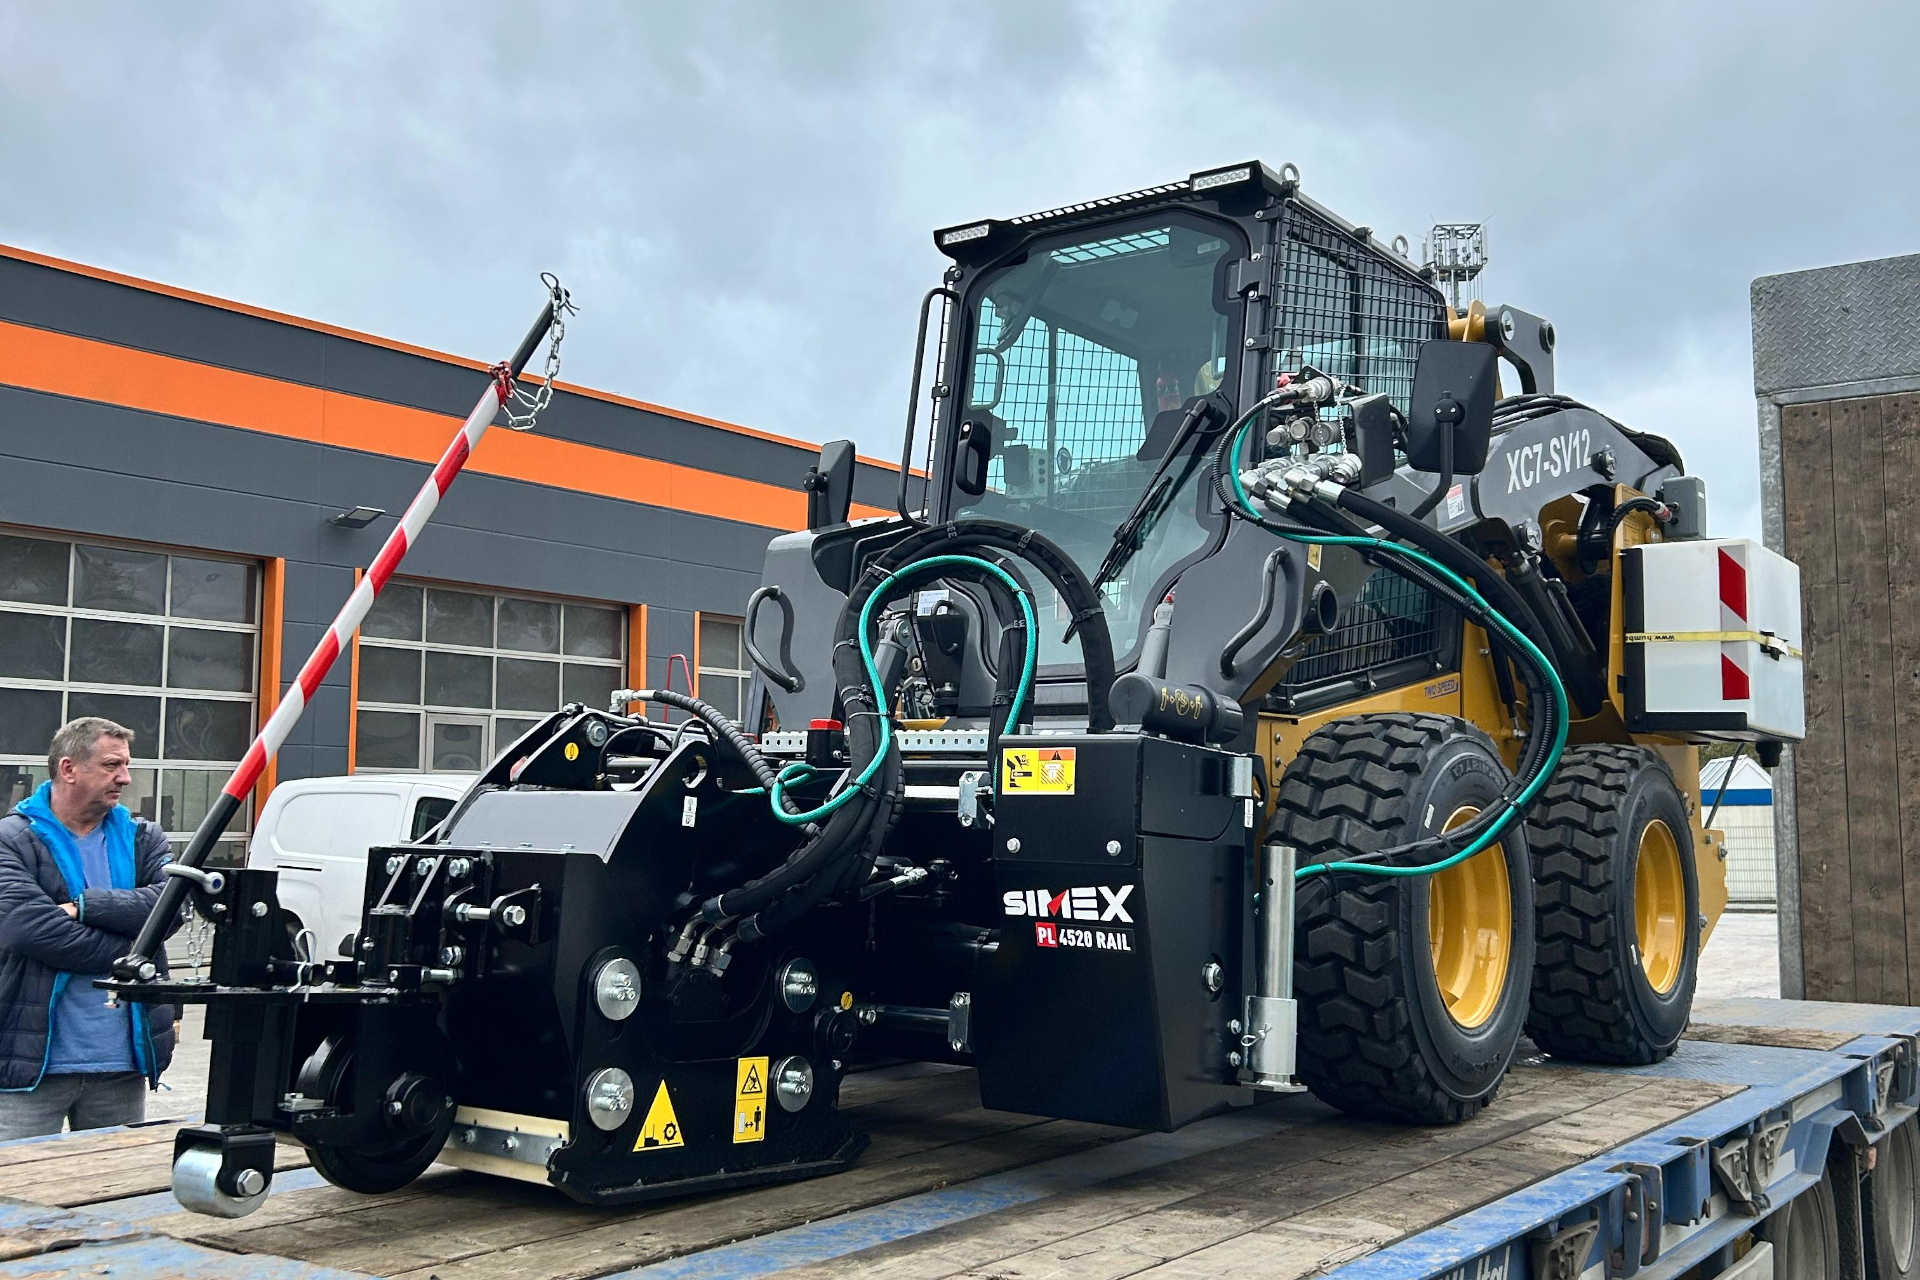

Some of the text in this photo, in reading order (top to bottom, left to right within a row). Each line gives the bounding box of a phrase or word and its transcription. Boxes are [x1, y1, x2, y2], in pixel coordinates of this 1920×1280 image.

[1506, 428, 1591, 494] XC7-SV12
[1437, 679, 1454, 694] SPEED
[1003, 884, 1134, 923] SIMEX
[1037, 927, 1131, 951] PL 4520 RAIL
